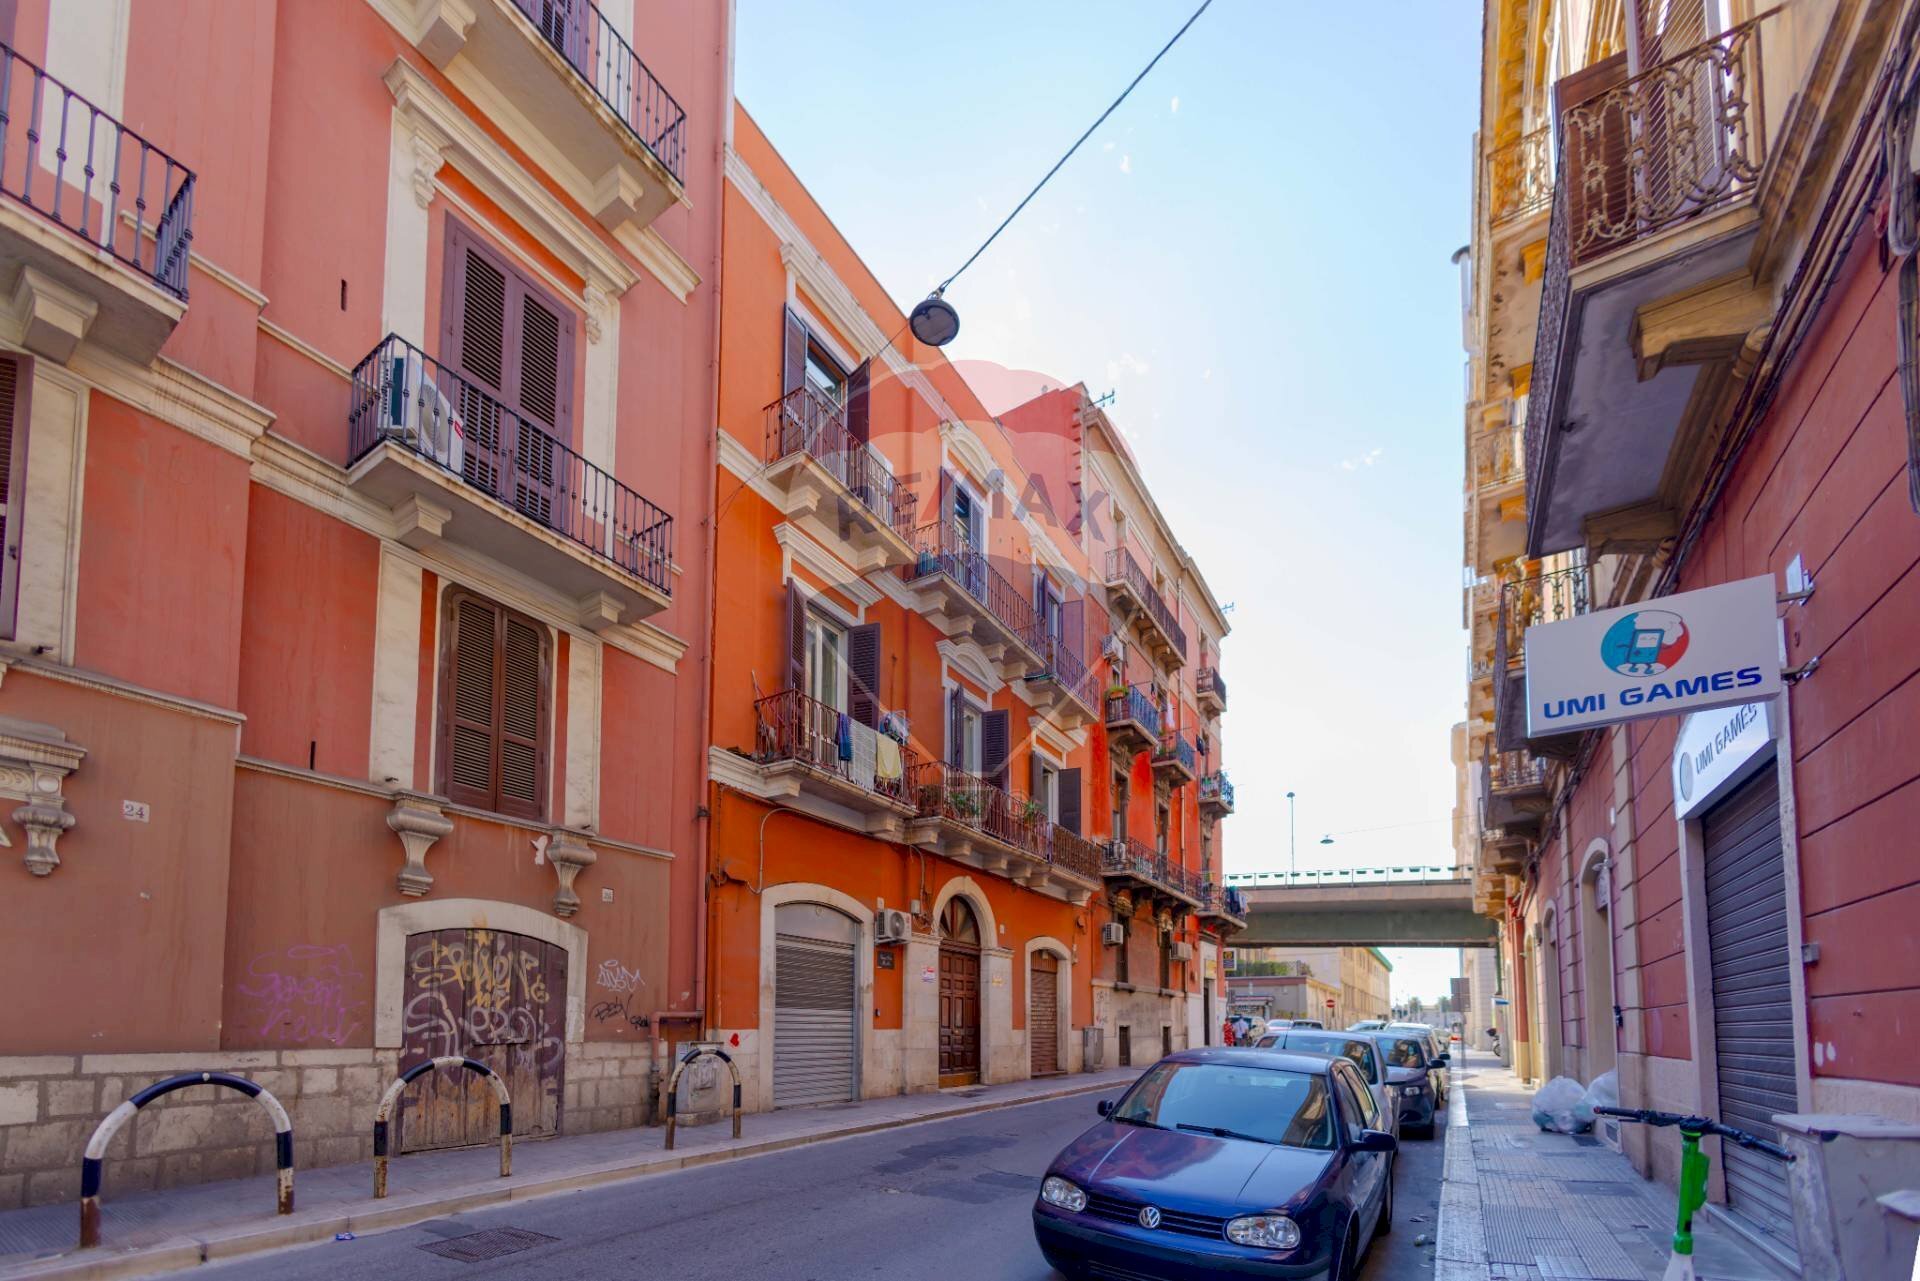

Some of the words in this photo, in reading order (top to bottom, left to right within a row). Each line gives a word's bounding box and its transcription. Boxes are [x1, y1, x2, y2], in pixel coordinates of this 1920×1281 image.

[1543, 692, 1606, 719] UMI
[1618, 666, 1763, 706] GAMES
[1694, 742, 1714, 775] UMI
[1714, 703, 1758, 755] GAMES
[124, 803, 146, 819] 24
